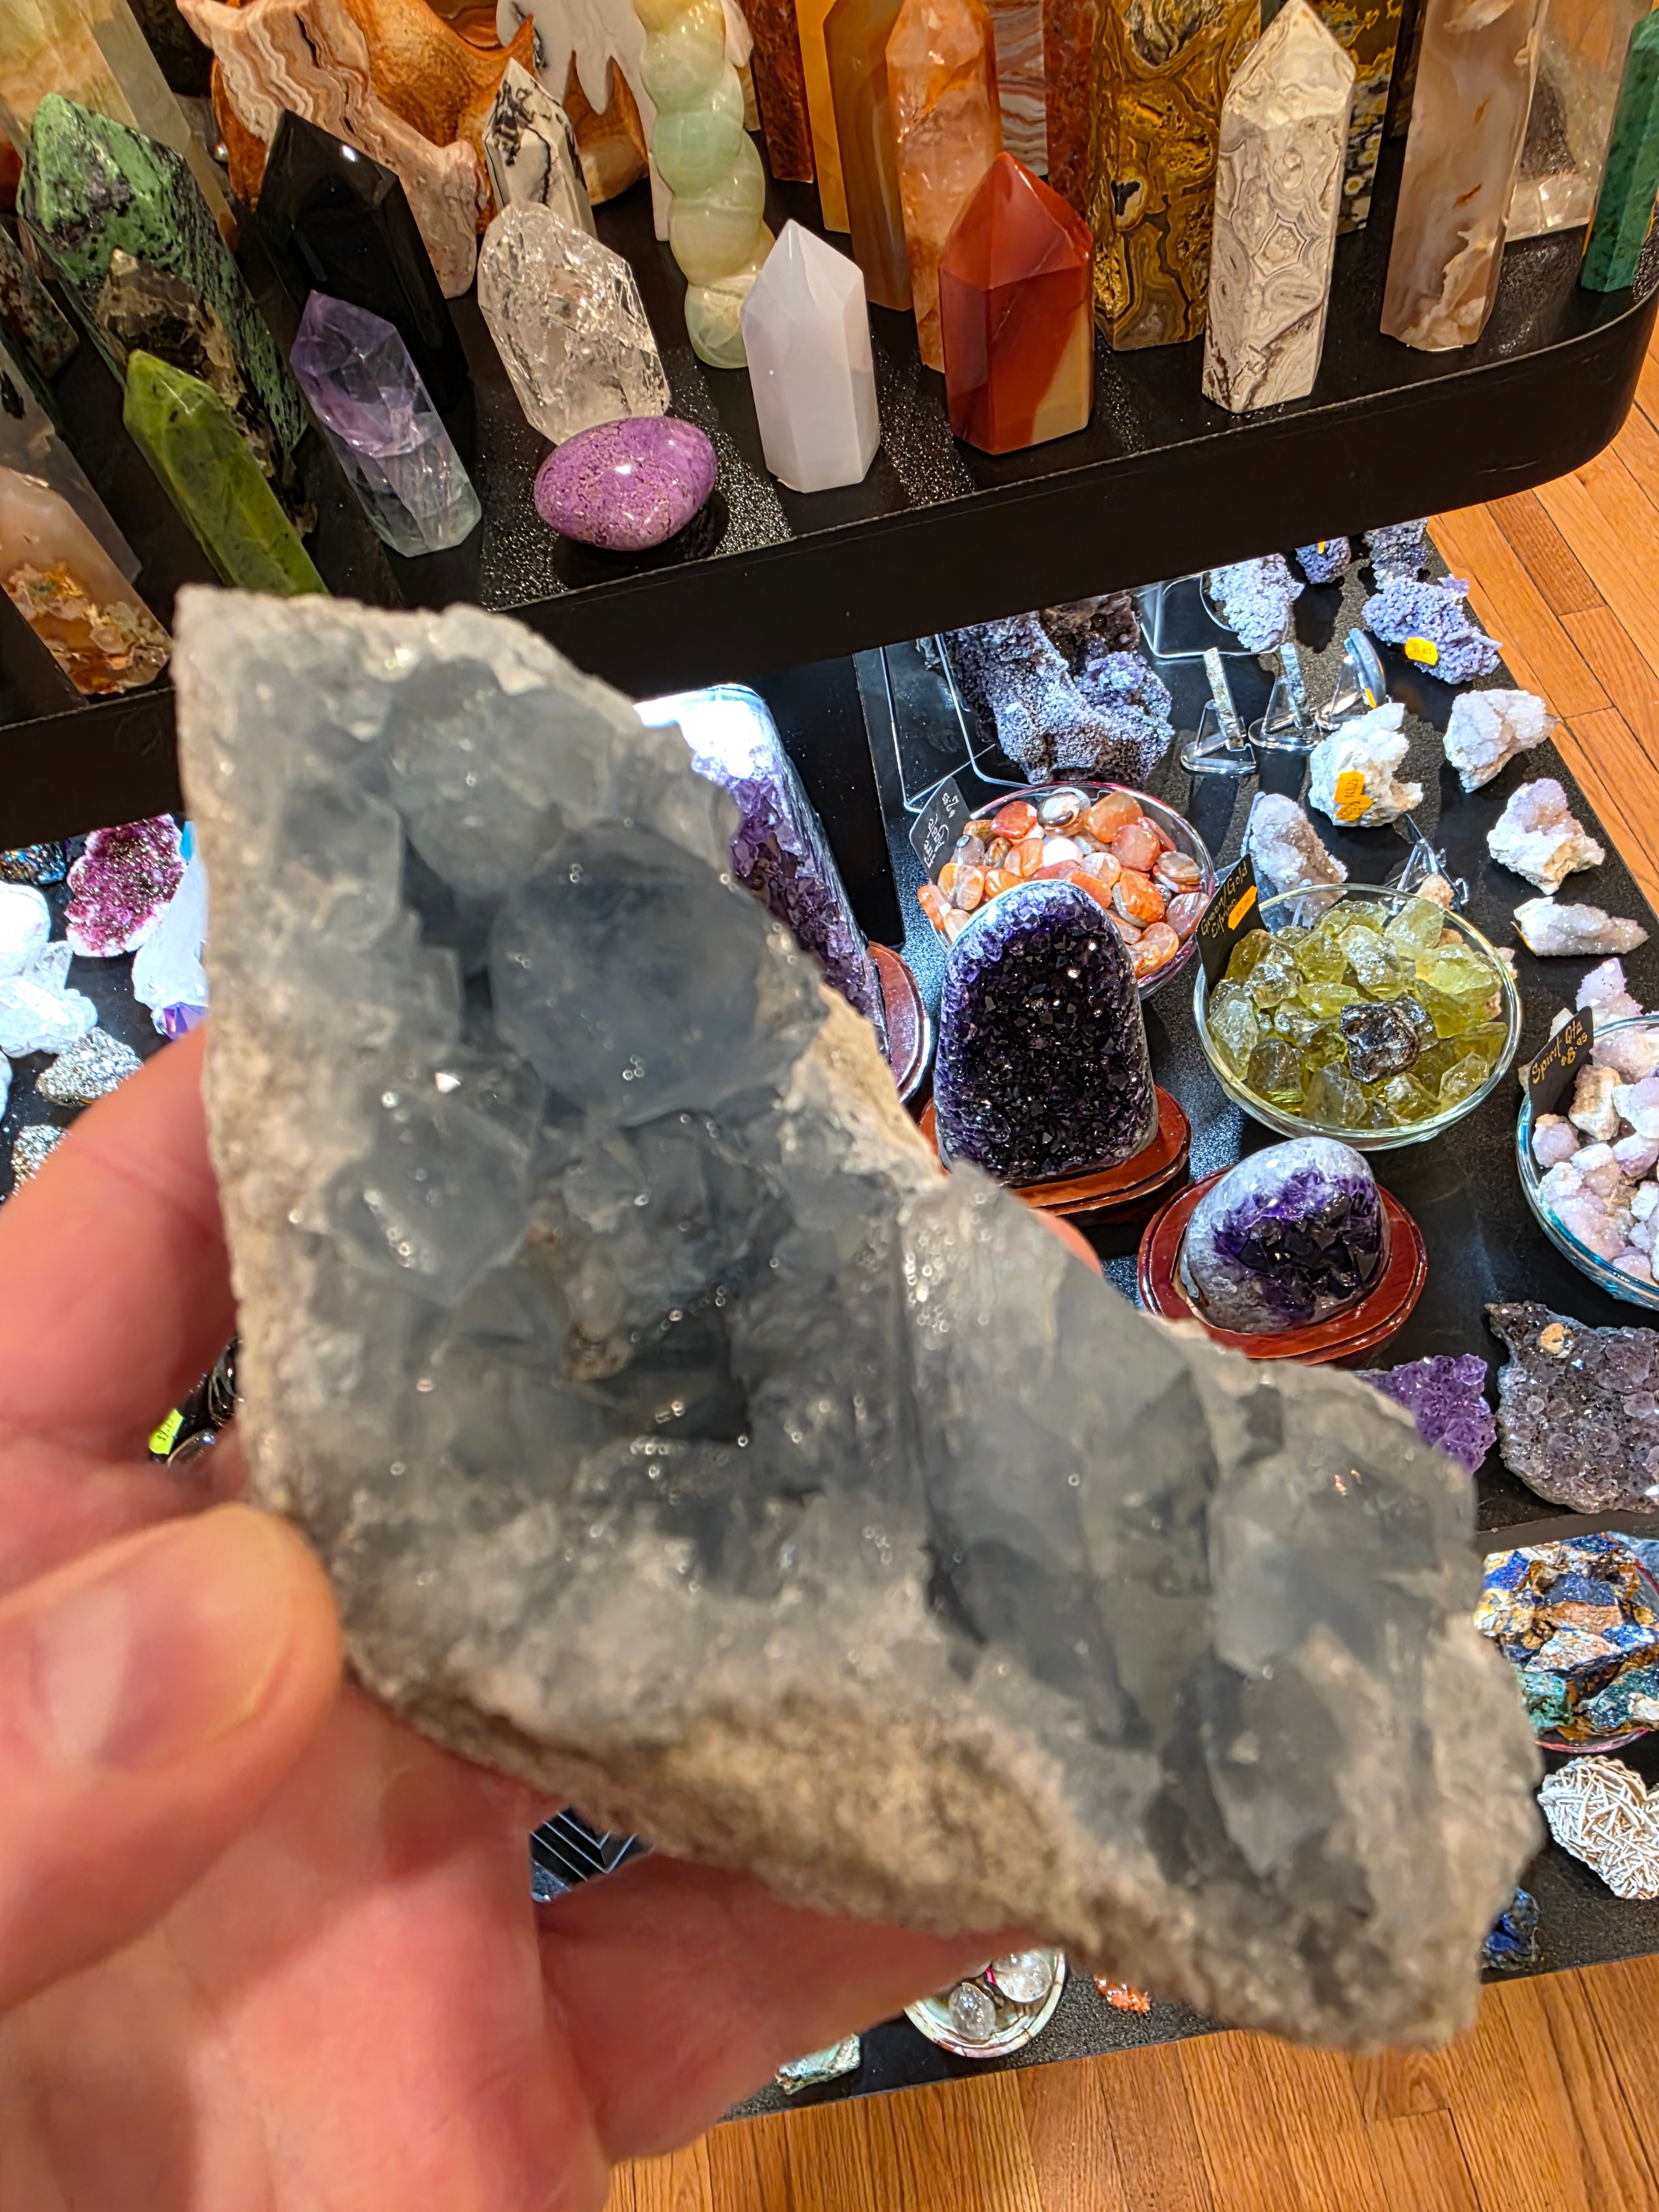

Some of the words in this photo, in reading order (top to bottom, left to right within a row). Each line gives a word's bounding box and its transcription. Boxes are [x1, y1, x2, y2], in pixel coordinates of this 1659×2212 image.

[927, 813, 949, 852] Agate
[924, 839, 936, 868] Fire
[1532, 1035, 1562, 1084] Spirit
